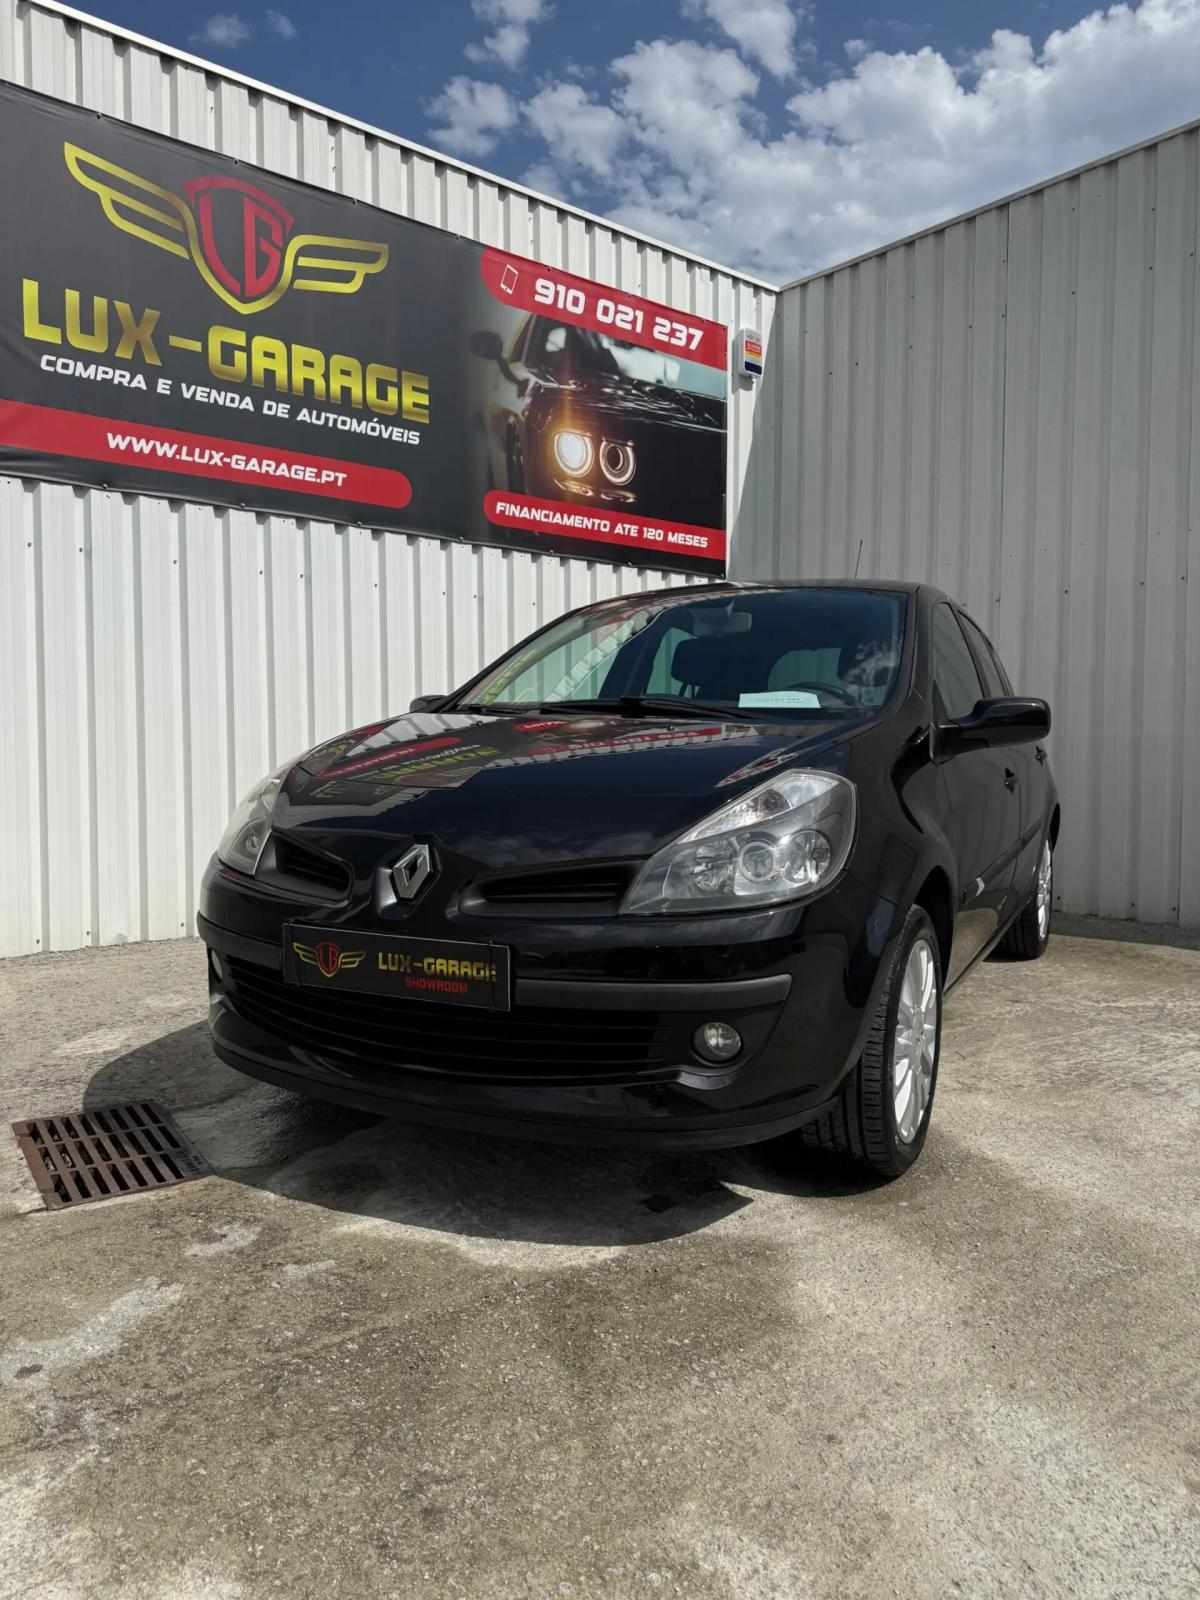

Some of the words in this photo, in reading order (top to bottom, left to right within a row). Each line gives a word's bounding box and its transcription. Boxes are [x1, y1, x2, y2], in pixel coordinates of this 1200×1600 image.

[533, 277, 586, 315] 910
[595, 300, 644, 334] 021
[652, 317, 704, 351] 237
[40, 354, 147, 391] COMPRA
[157, 379, 172, 395] E
[181, 383, 254, 412] VENDA
[263, 400, 290, 419] DE
[297, 407, 421, 445] AUTOMÓVEIS
[106, 432, 348, 487] WWW.LUX-GARAGE.PT
[496, 502, 610, 533] FINANCIAMENTO
[614, 523, 638, 538] ATE
[643, 527, 664, 541] 120
[667, 531, 708, 548] MESES
